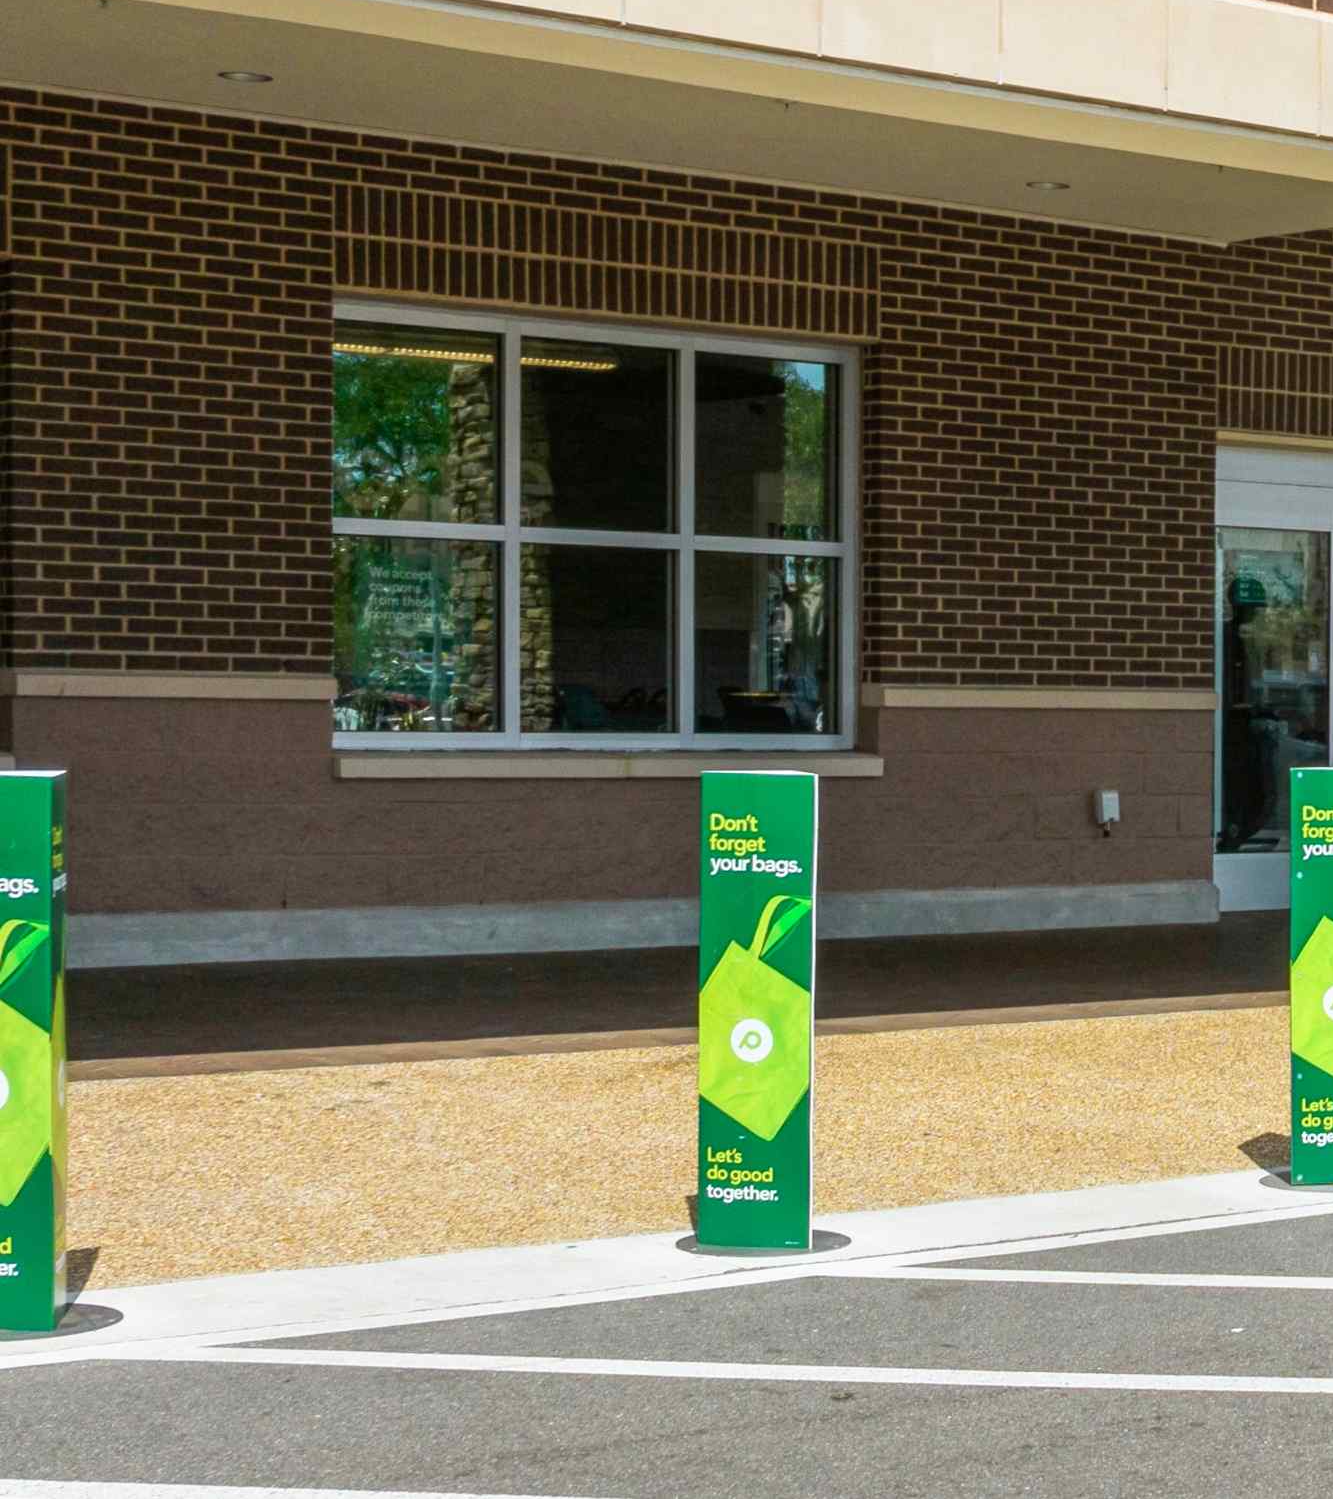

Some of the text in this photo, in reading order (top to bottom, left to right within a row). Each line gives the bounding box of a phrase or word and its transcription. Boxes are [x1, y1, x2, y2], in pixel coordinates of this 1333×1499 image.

[710, 812, 759, 832] Don't
[709, 833, 766, 856] forget
[710, 854, 803, 877] your bags.
[1302, 1098, 1333, 1112] Let's
[1301, 1113, 1321, 1127] do
[707, 1146, 742, 1164] Let's
[707, 1164, 773, 1185] do good
[706, 1184, 778, 1203] together.
